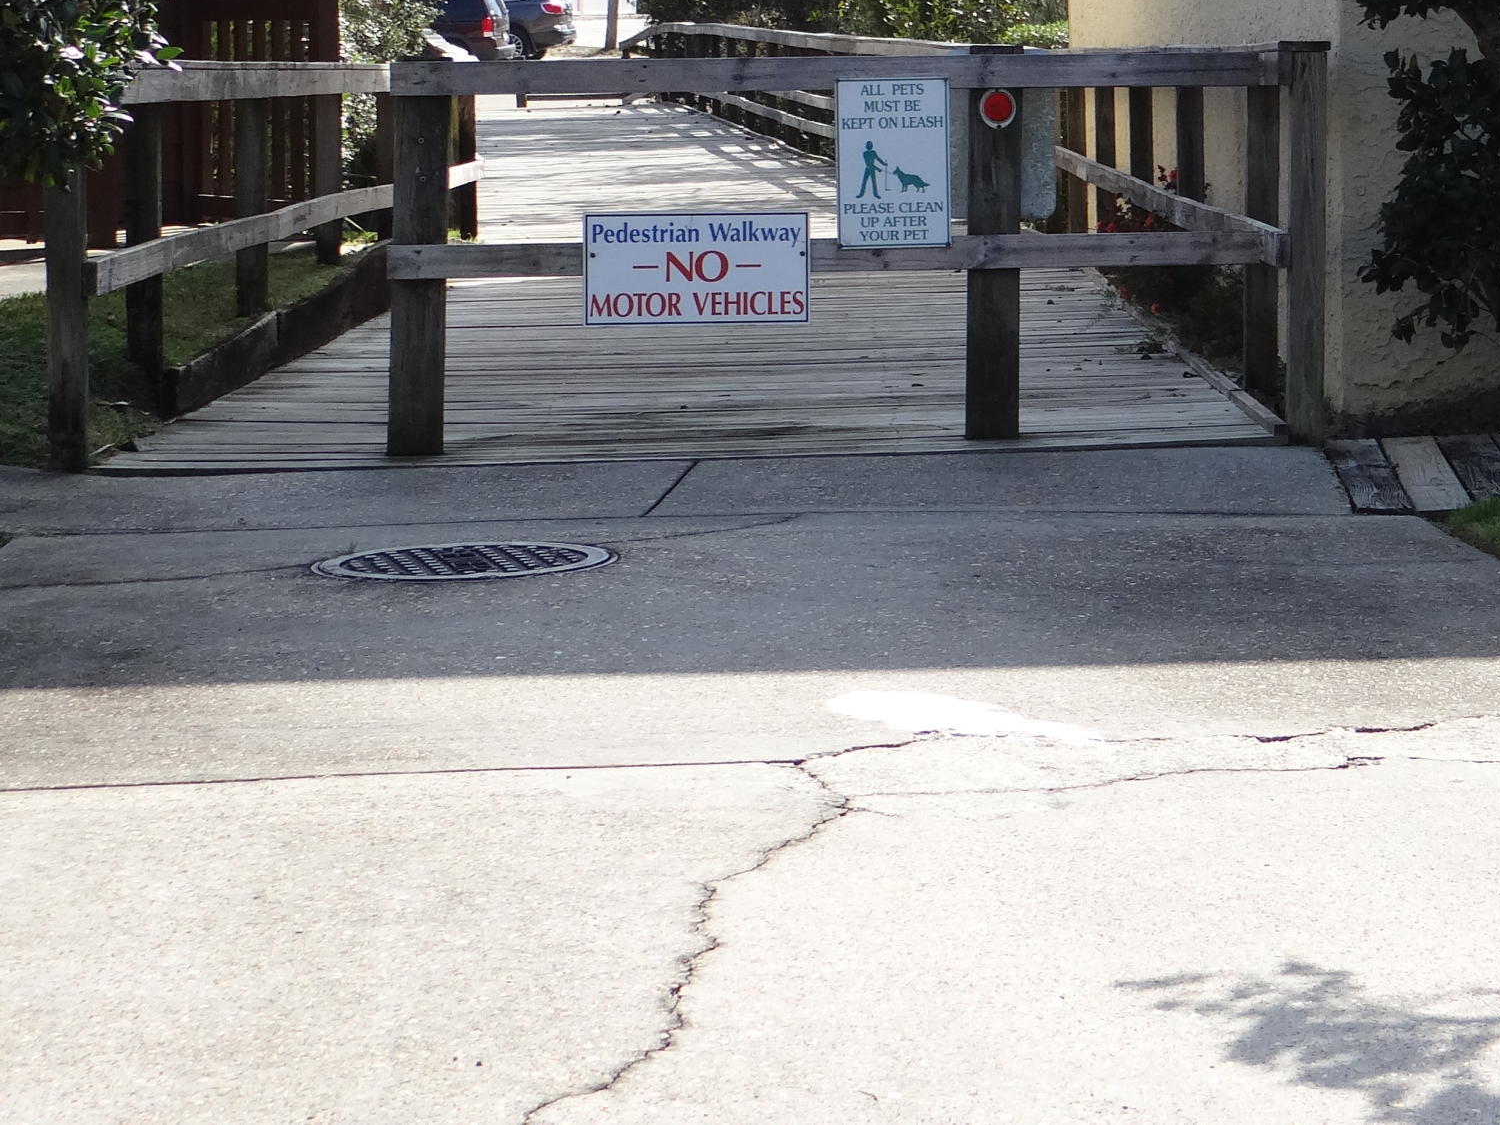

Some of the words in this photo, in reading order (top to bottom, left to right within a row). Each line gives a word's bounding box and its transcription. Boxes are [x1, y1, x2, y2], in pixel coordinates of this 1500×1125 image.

[861, 84, 887, 96] ALL
[892, 83, 925, 95] PETS
[864, 100, 900, 112] MUST
[904, 100, 921, 112] BE
[841, 117, 875, 130] KEPT
[879, 117, 898, 129] ON
[902, 116, 944, 128] LEASH
[844, 202, 894, 214] PLEASE
[898, 201, 944, 213] CLEAN
[861, 217, 880, 228] UP
[883, 216, 927, 227] AFTER
[592, 222, 699, 243] Pedestrian
[708, 221, 801, 248] Walkway
[859, 230, 899, 241] YOUR
[903, 229, 929, 241] PET
[665, 250, 729, 282] NO
[589, 293, 682, 317] MOTOR
[693, 291, 804, 316] VEHICLES
